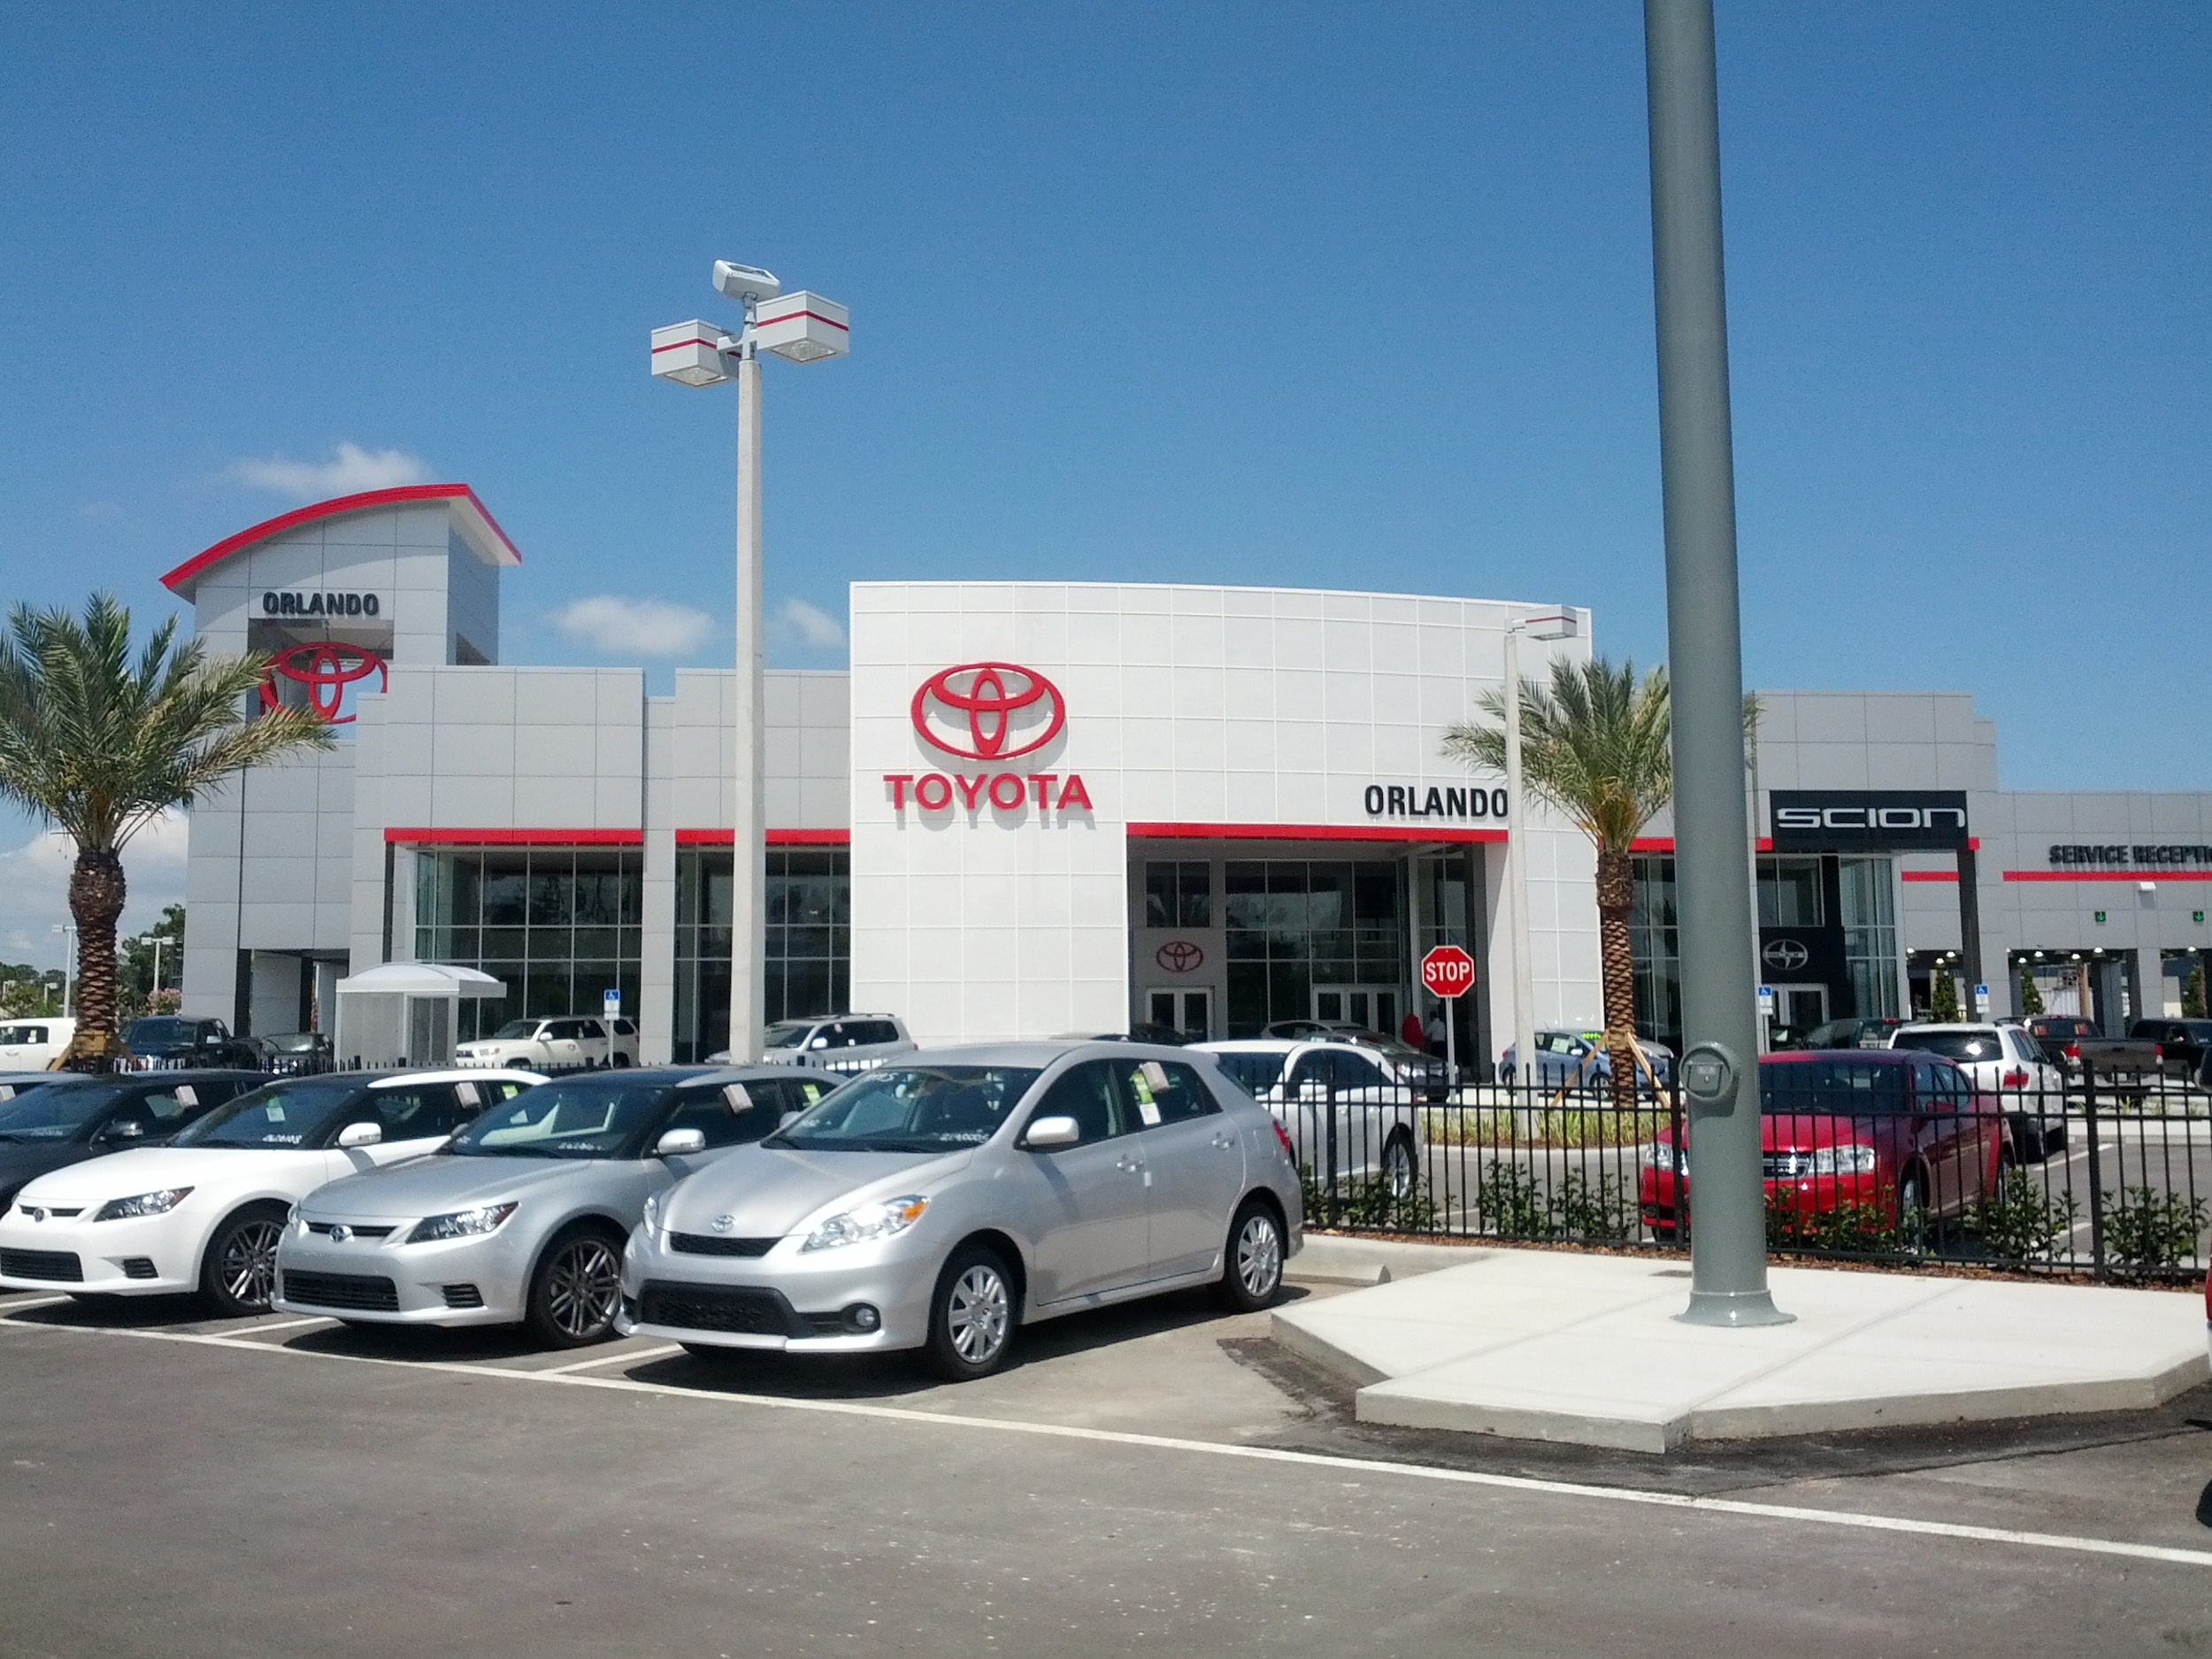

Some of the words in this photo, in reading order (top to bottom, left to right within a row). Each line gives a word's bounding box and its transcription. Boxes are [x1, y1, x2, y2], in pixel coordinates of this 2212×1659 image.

[263, 592, 380, 616] ORLANDO
[883, 772, 1094, 810] TOYOTA
[1364, 785, 1509, 818] ORLANDO
[1777, 808, 1966, 828] SCION
[2049, 845, 2129, 864] SERVICE
[2132, 845, 2212, 864] RECEPTI
[1425, 961, 1471, 982] STOP
